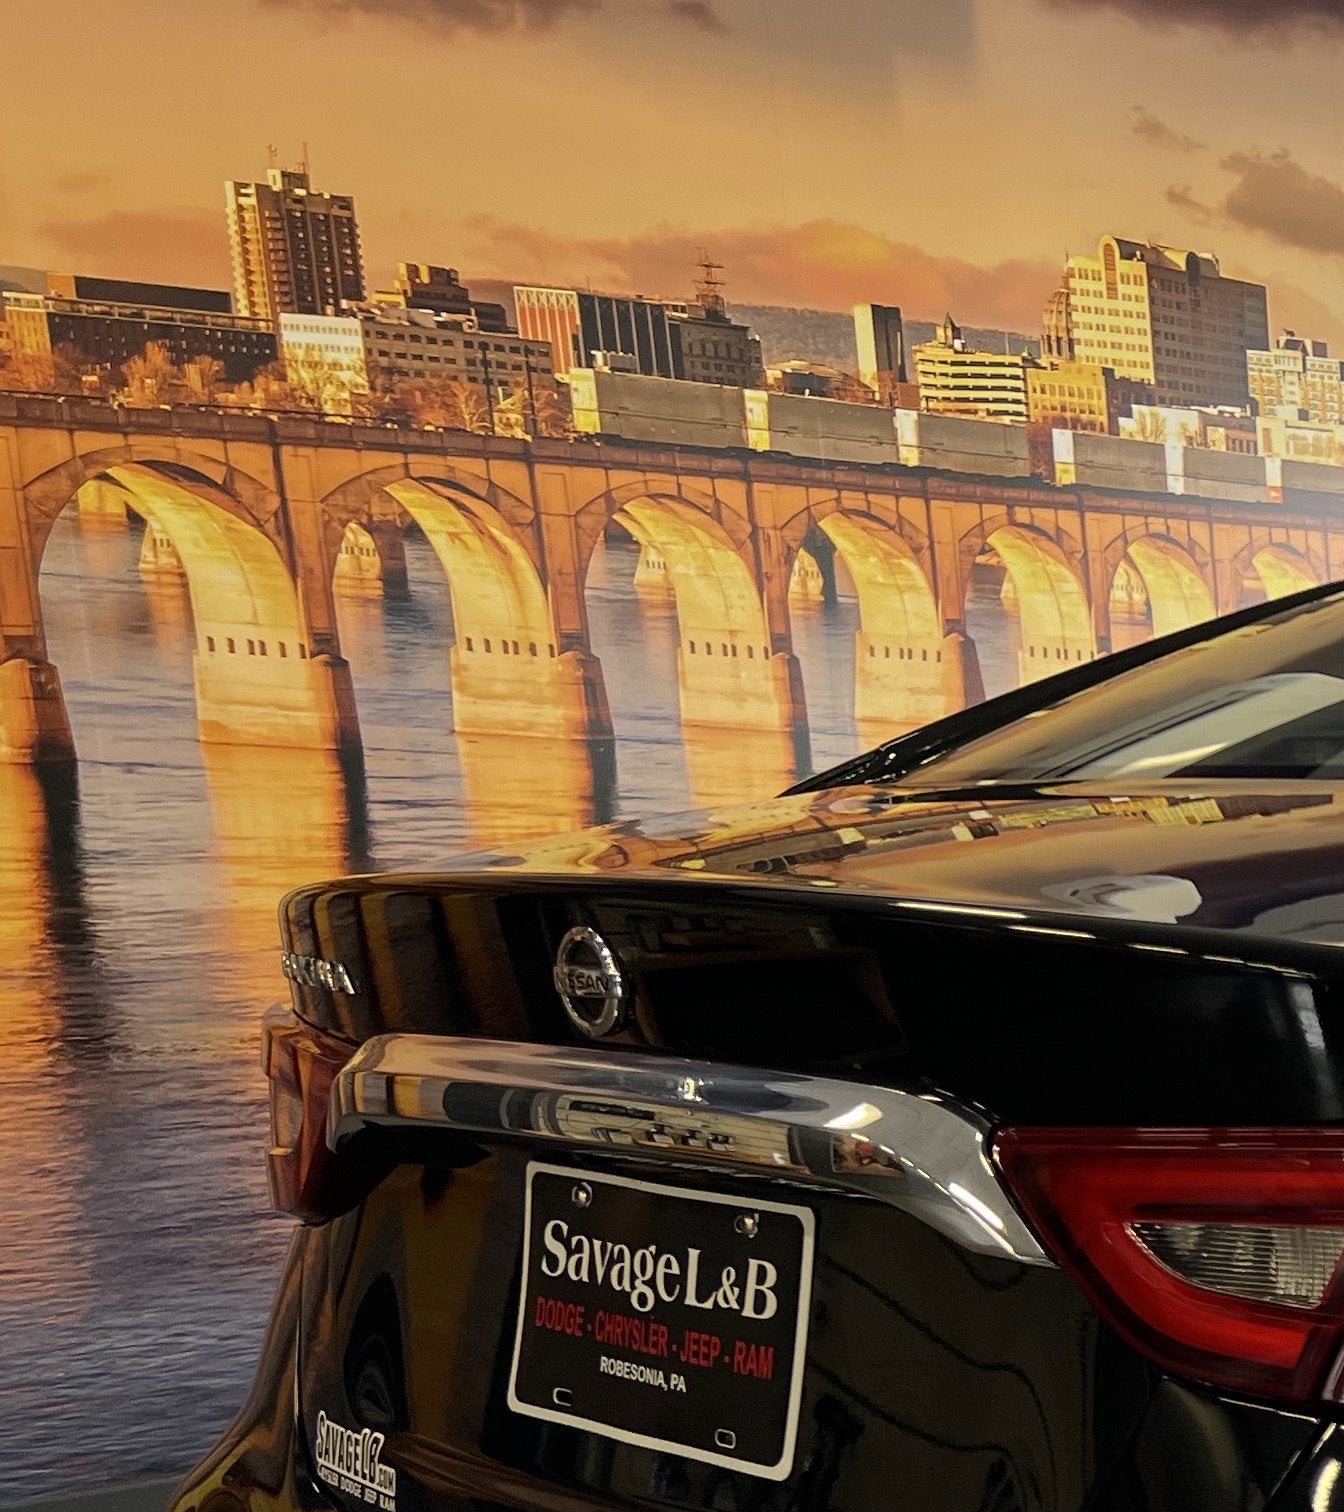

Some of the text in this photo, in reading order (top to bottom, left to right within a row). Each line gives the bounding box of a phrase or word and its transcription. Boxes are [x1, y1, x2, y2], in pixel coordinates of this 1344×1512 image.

[534, 1296, 776, 1380] DODGE CHRYSLER JEEP RAM
[599, 1355, 687, 1394] ROBESONIA, PA
